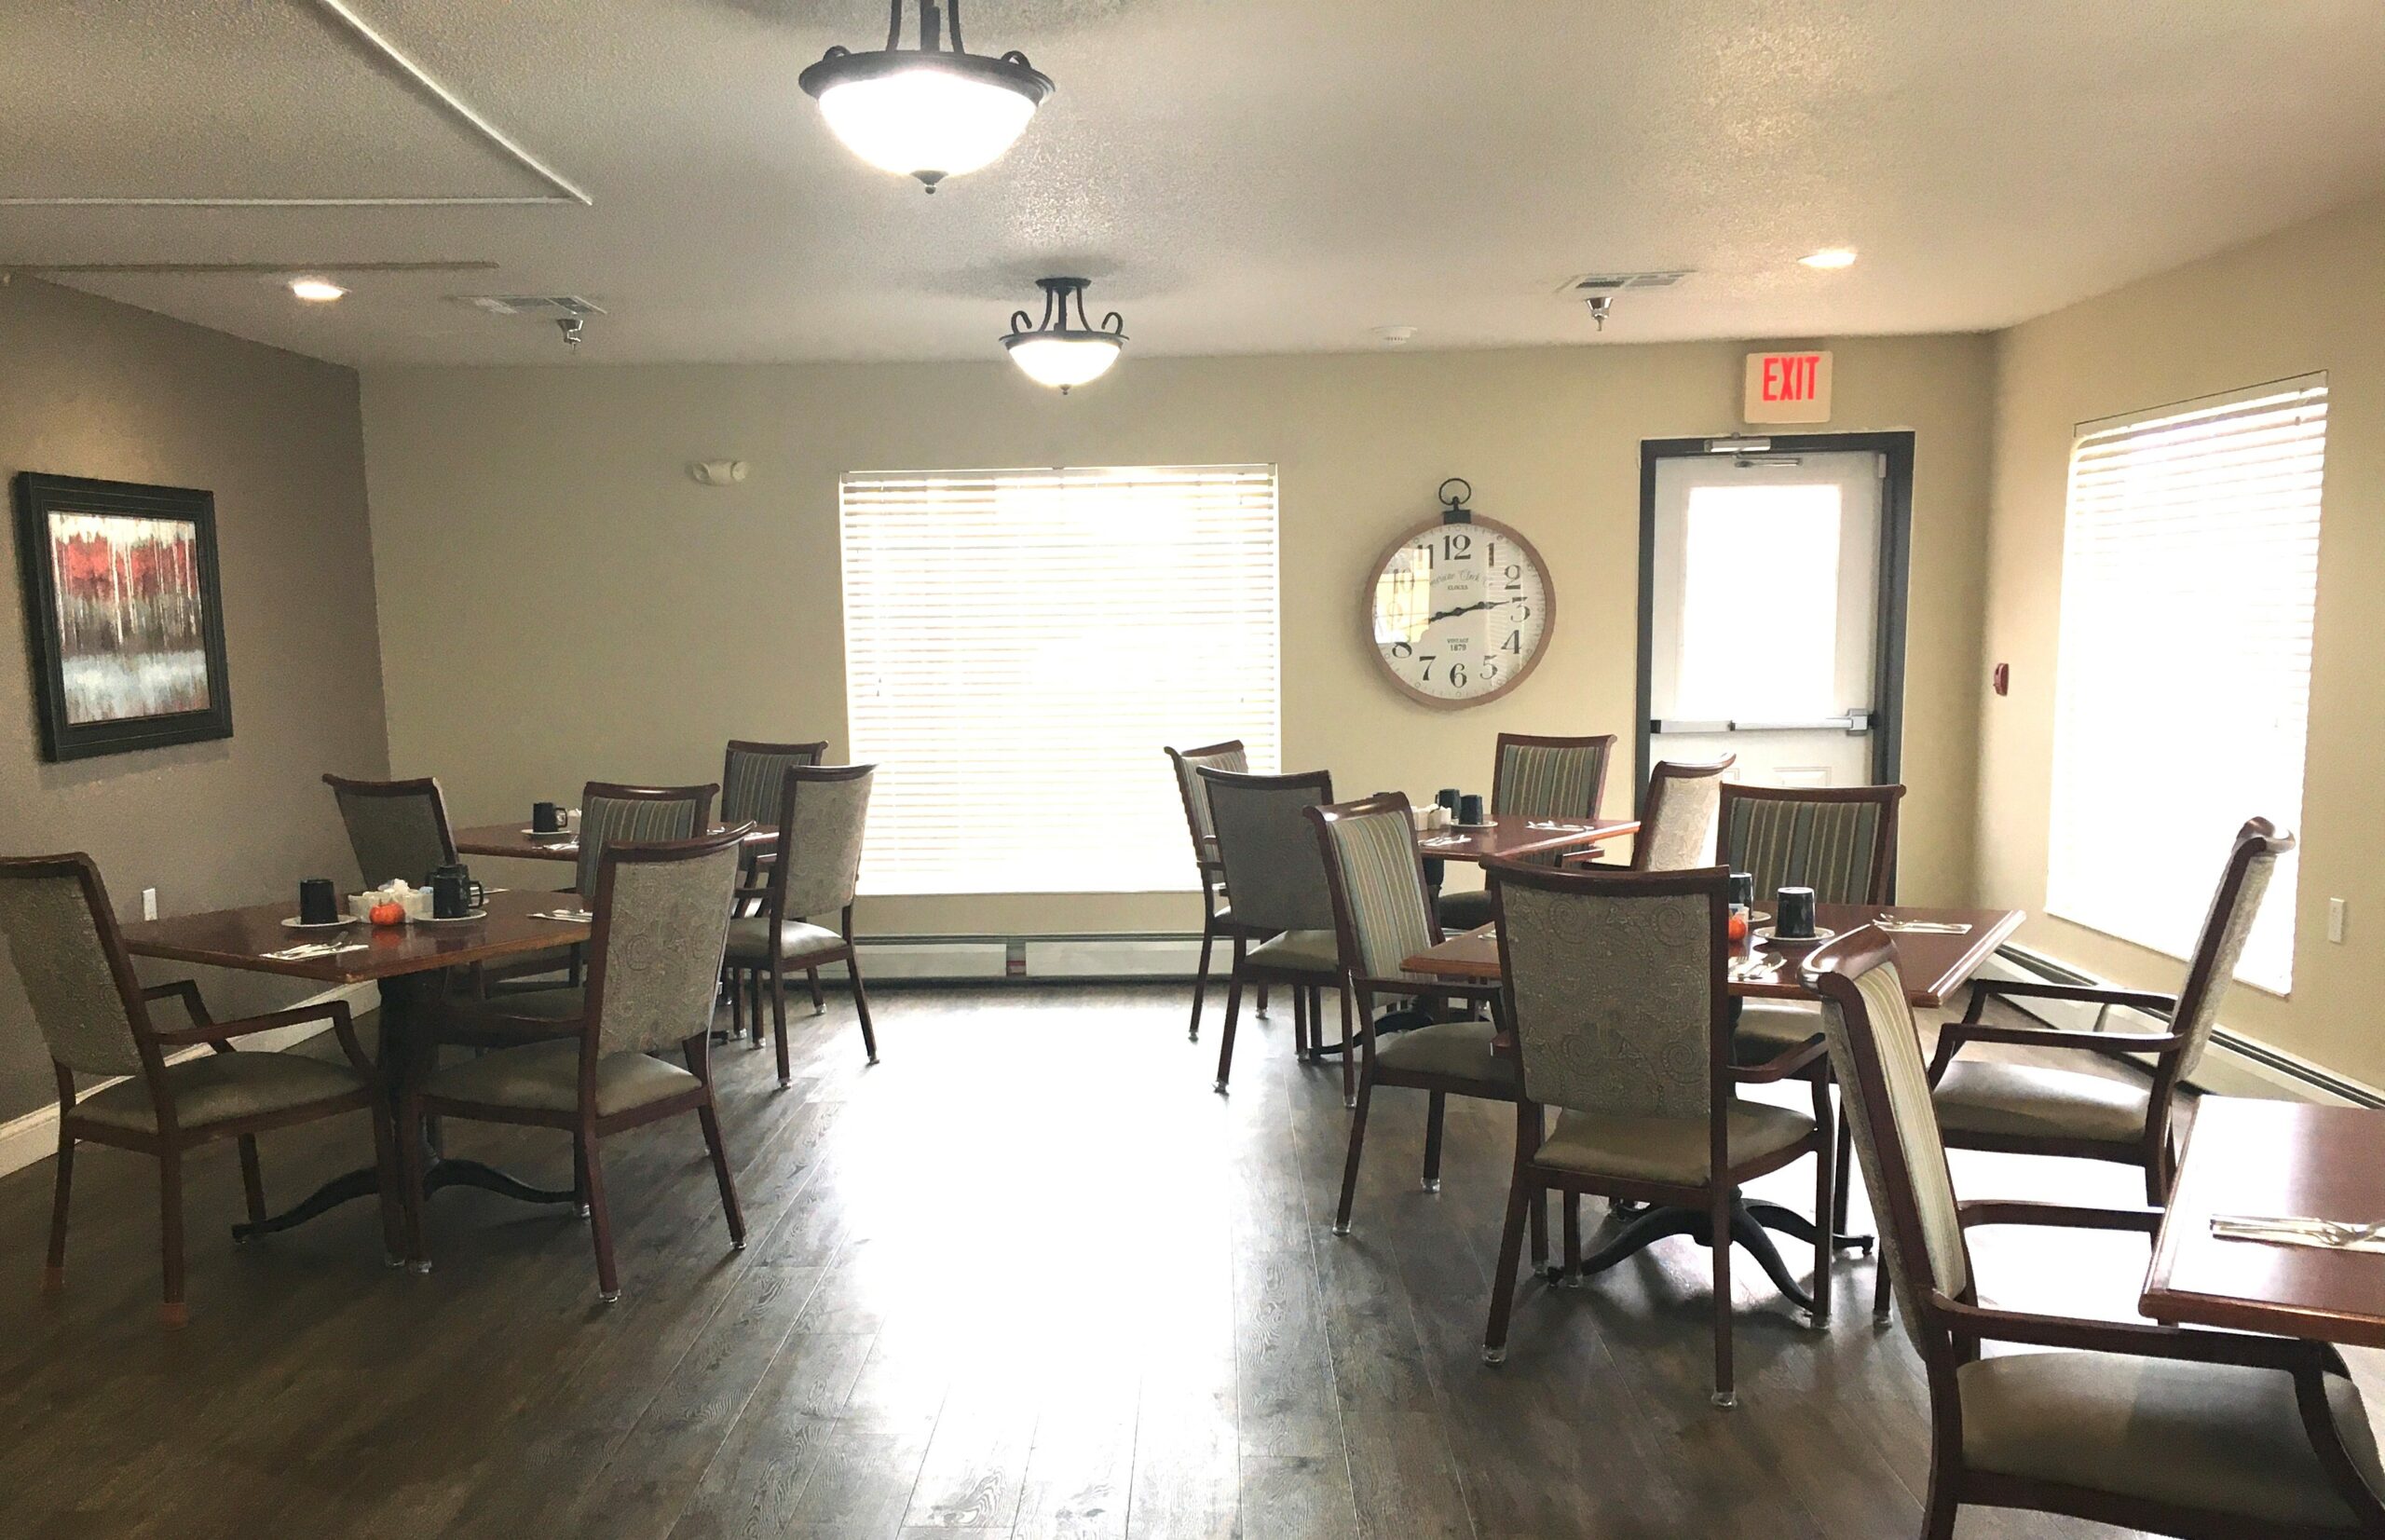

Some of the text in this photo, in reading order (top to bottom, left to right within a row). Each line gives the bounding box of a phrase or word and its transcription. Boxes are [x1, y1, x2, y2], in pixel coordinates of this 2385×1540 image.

[1764, 356, 1820, 401] EXIT
[1417, 544, 1434, 569] 11
[1443, 534, 1471, 560] 12
[1487, 542, 1494, 568] 1
[1505, 565, 1520, 590] 2
[1511, 596, 1531, 622] 3
[1501, 630, 1521, 655] 4
[1419, 656, 1437, 681] 7
[1450, 663, 1467, 688] 6
[1479, 655, 1498, 679] 5
